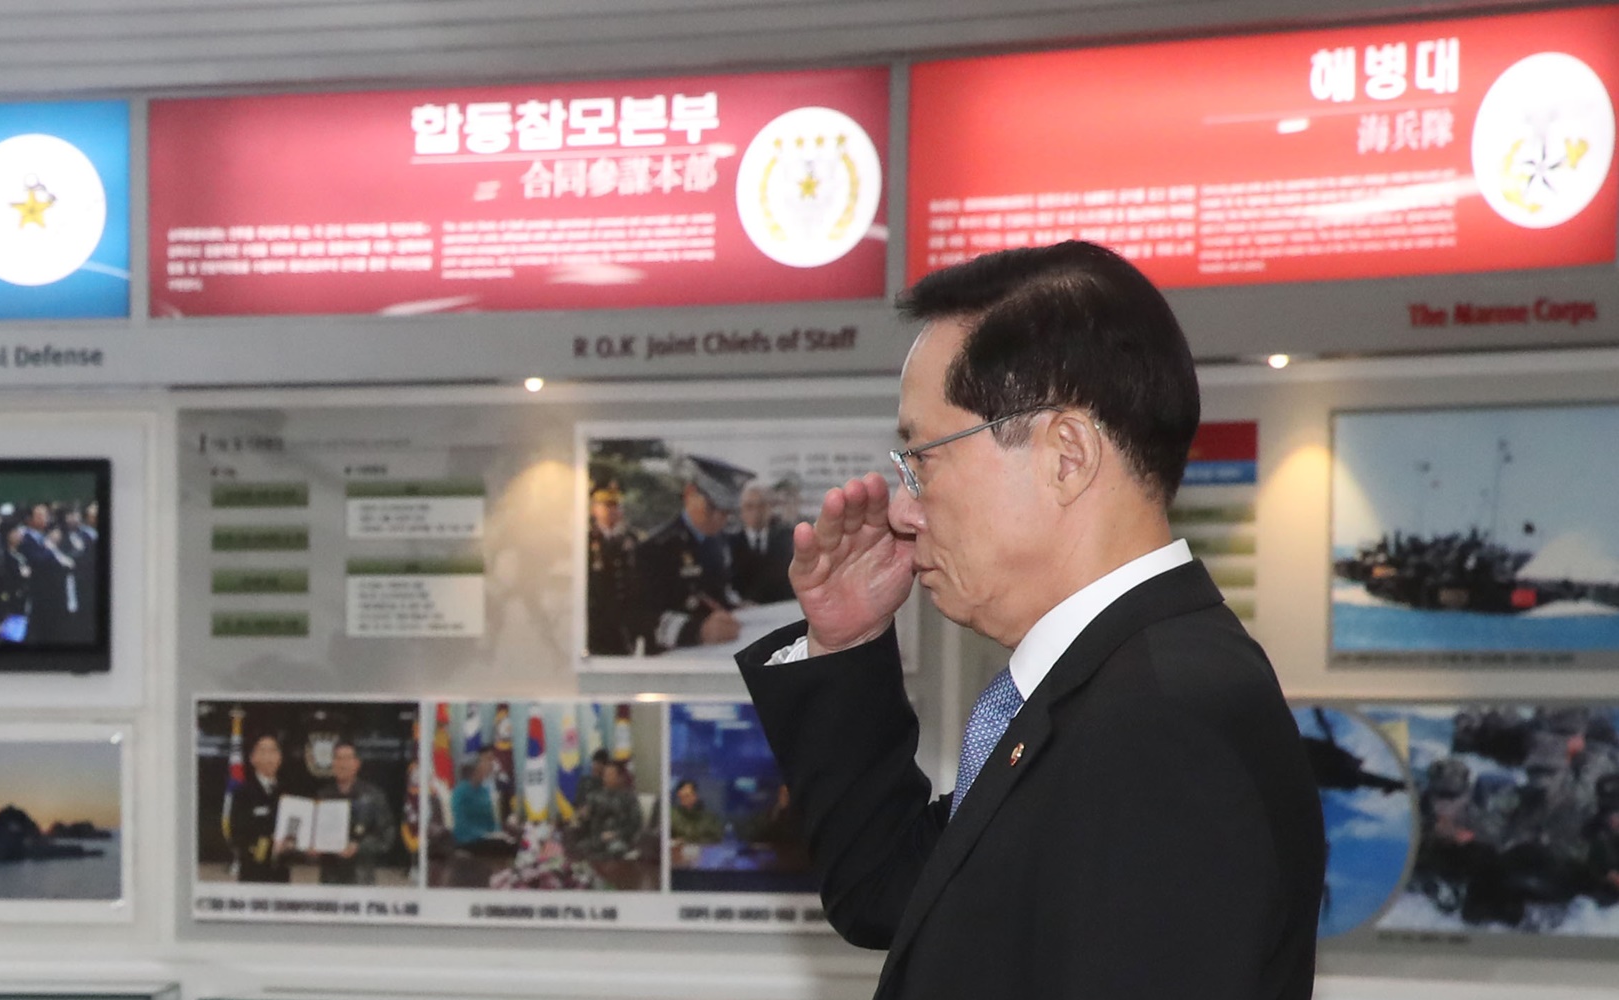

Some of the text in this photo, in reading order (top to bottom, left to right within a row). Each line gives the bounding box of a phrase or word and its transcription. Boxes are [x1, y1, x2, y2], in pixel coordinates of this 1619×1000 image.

[1310, 37, 1460, 102] 해병대
[411, 92, 720, 154] 합동참모본부
[1410, 298, 1597, 327] The Marine Corps
[14, 344, 103, 369] Defense
[646, 331, 696, 360] Joint
[702, 328, 771, 354] Chiefs
[776, 327, 800, 351] of
[805, 325, 858, 350] Staff
